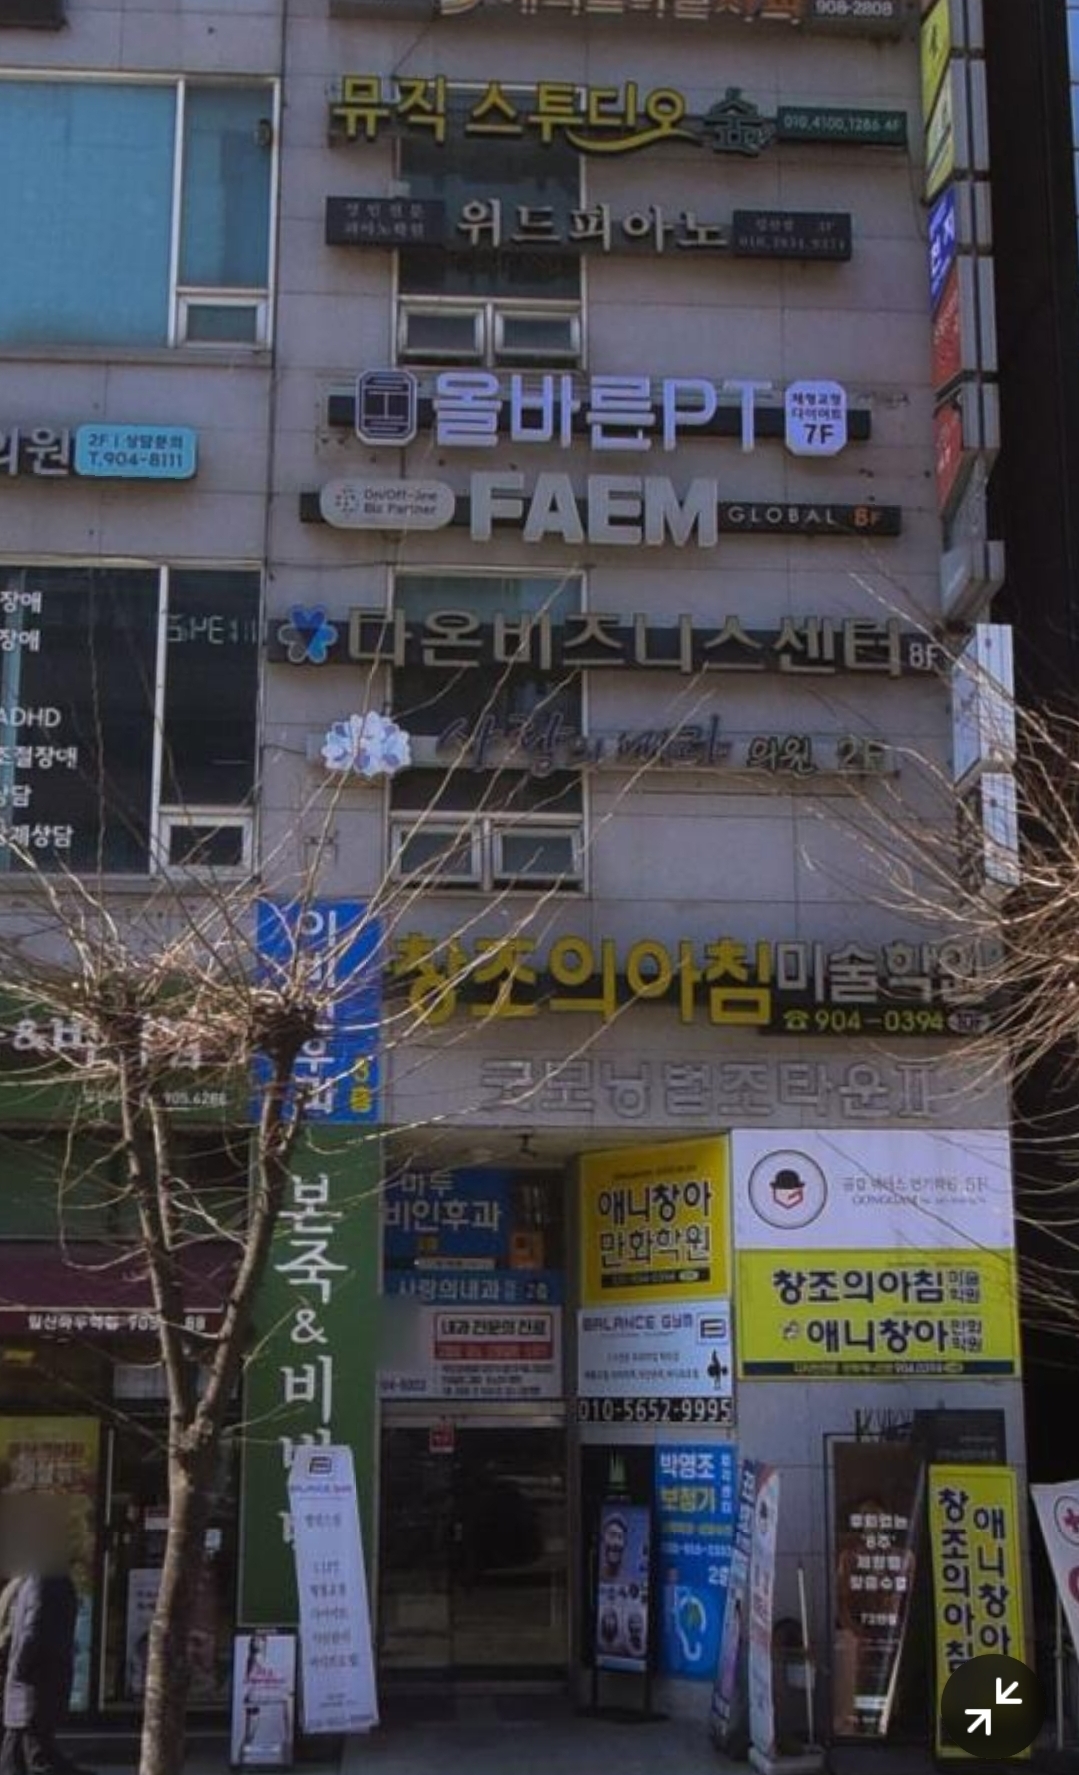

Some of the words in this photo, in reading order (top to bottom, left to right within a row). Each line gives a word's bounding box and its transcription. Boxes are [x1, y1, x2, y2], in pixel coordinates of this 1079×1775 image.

[332, 75, 446, 145] 뮤직
[456, 199, 729, 252] 위드피아노
[432, 371, 774, 452] 올바른PT
[803, 423, 834, 443] 7F
[88, 432, 107, 447] 2F
[89, 451, 182, 467] T.904-8111
[469, 473, 718, 547] FAEM
[728, 505, 836, 524] GLOBAL
[349, 608, 903, 678] 다온비즈니스센터
[908, 642, 939, 669] 8F
[388, 937, 772, 1027] 창조의아침
[815, 1010, 944, 1032] 904-0394
[598, 1180, 712, 1225] 애니창아
[599, 1225, 710, 1268] 만화학원
[773, 1269, 943, 1305] 창조의아침
[806, 1317, 948, 1354] 애니창아
[577, 1397, 731, 1421] 010-5652-9995
[937, 1488, 974, 1674] 창조의아침
[973, 1507, 1011, 1657] 애니창아
